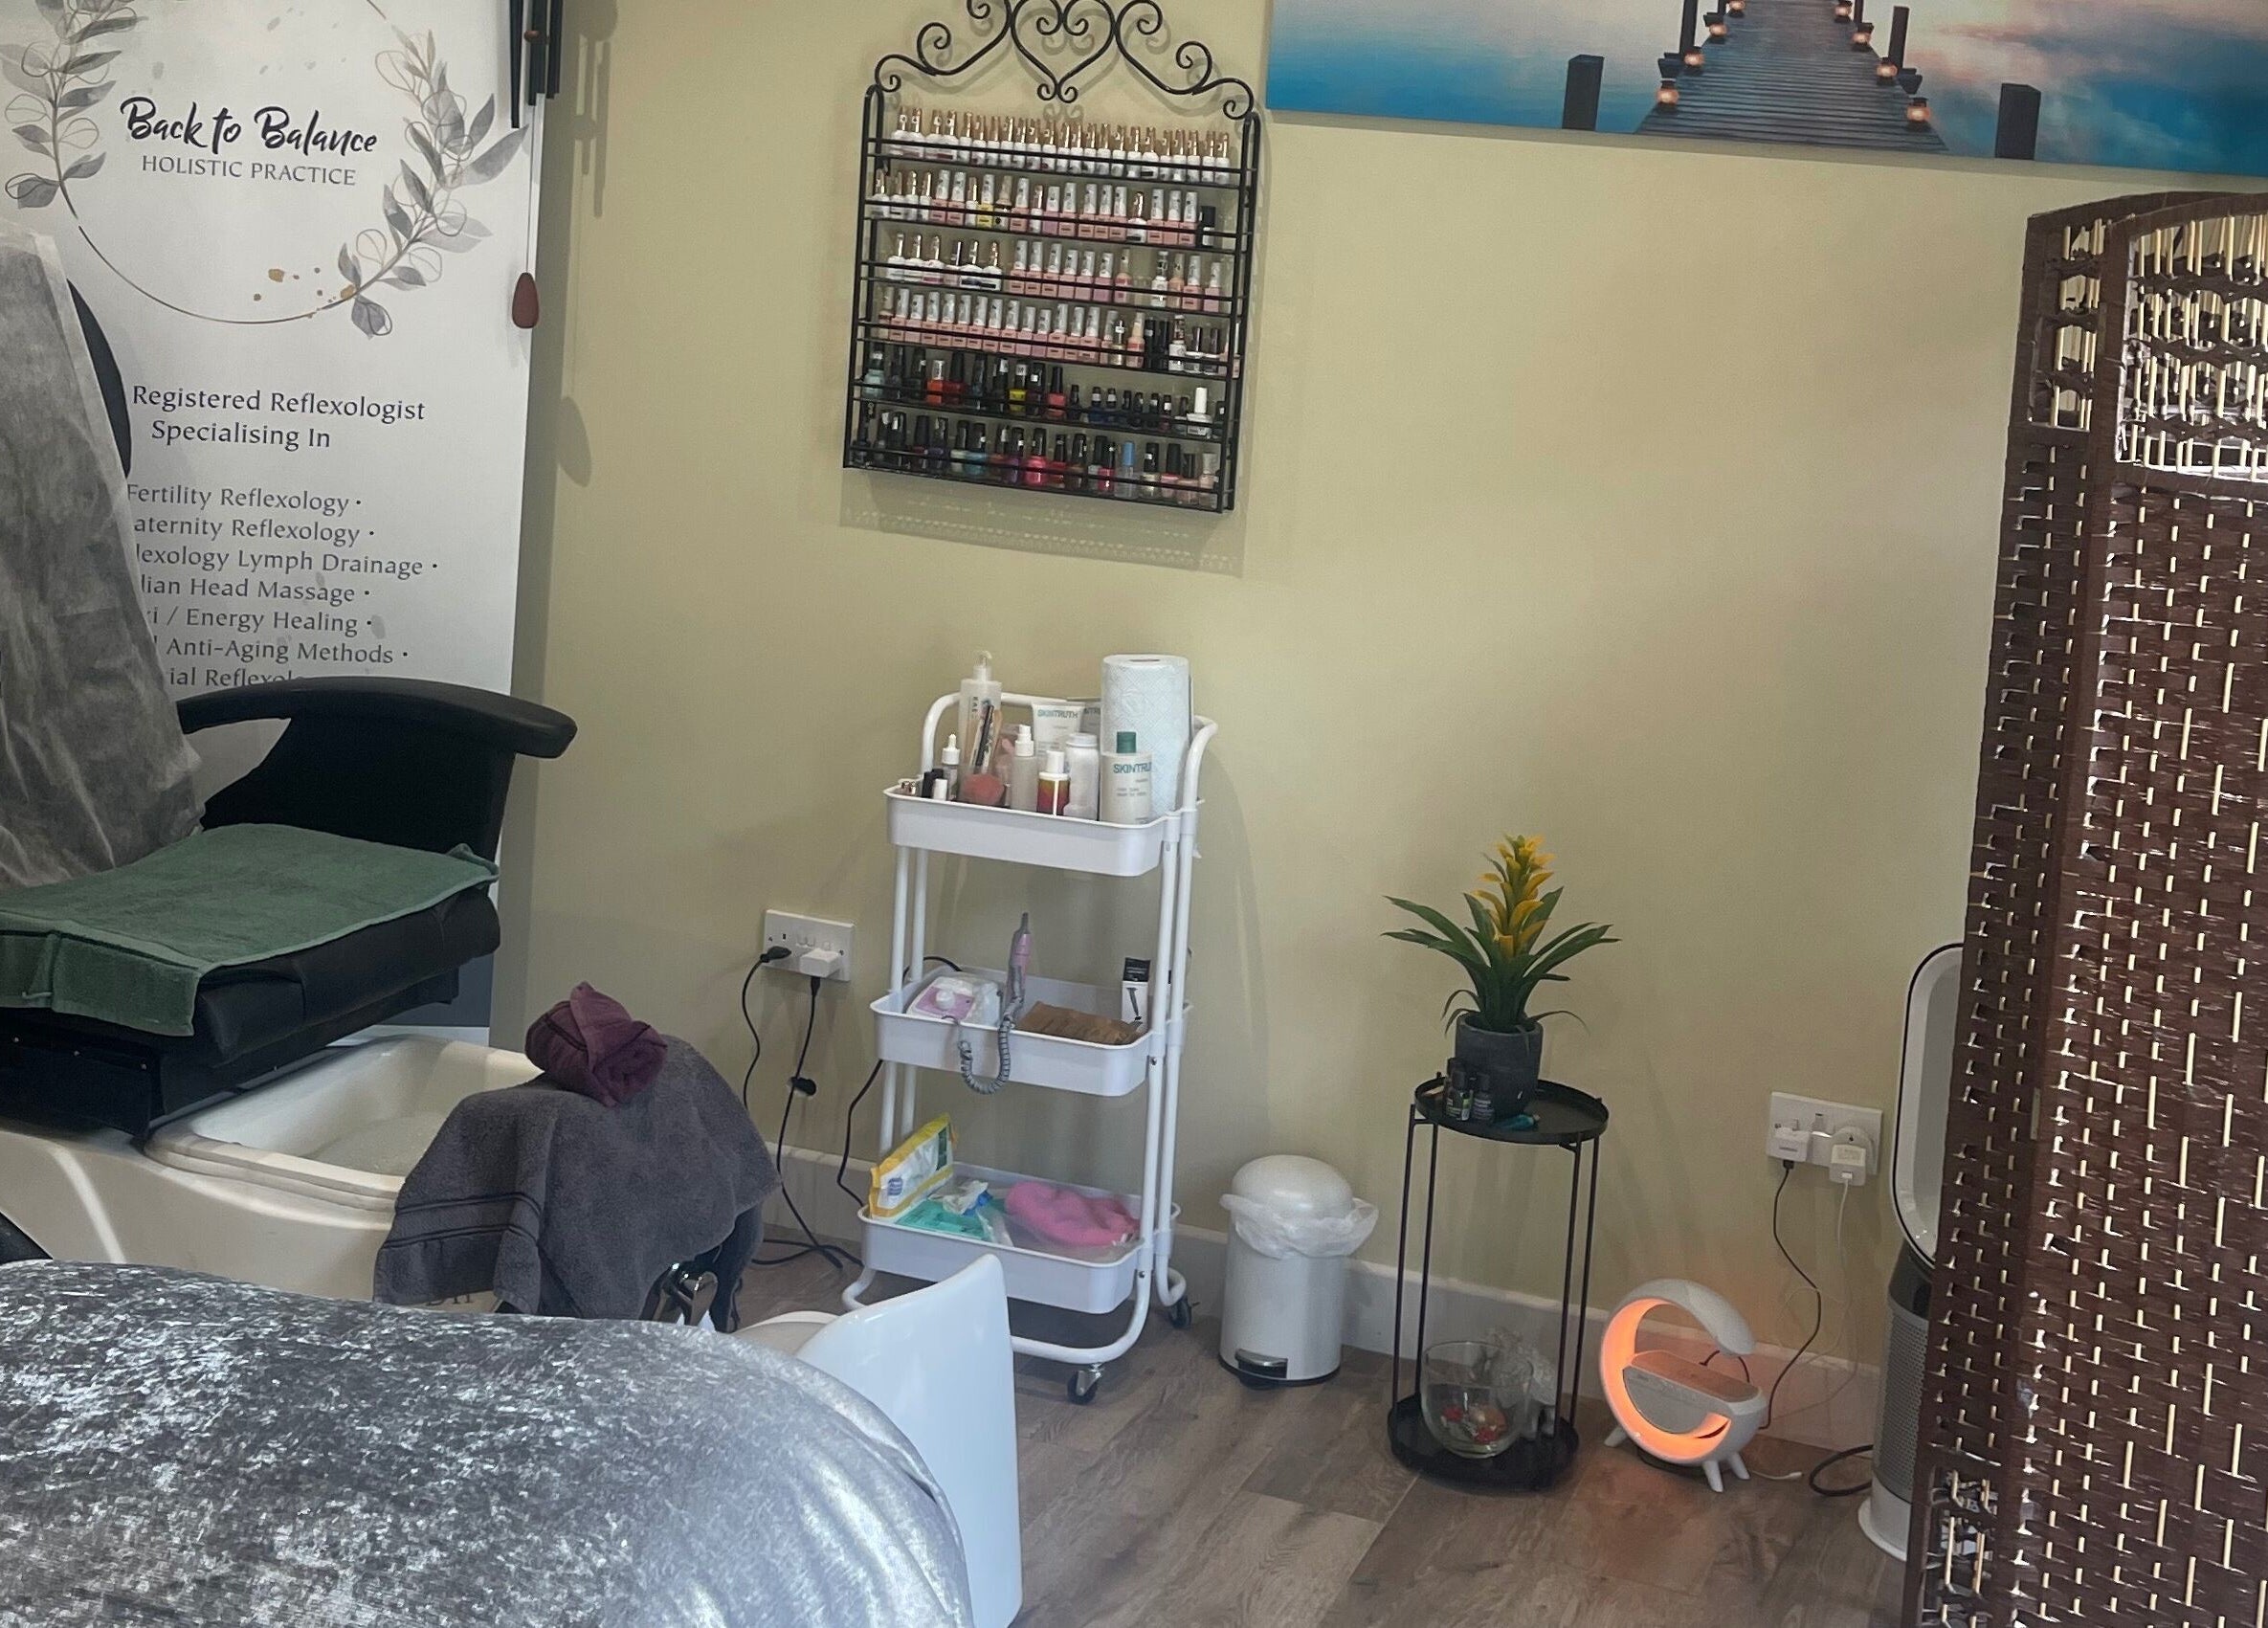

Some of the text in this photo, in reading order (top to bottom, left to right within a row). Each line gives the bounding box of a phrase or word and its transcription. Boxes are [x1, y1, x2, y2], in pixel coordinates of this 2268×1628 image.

[120, 96, 378, 156] Back to Balance
[142, 155, 357, 186] HOLISTIC PRACTICE
[133, 385, 426, 424] Registered Reflexologist
[151, 419, 331, 452] Specialising In
[126, 483, 350, 518] Fertility Reflexology
[134, 517, 361, 548] aternity Reflexology
[136, 543, 424, 581] lexology Lymph Drainage
[190, 577, 250, 597] Head
[257, 580, 356, 608] Massage
[186, 608, 265, 634] Energy
[273, 611, 359, 638] Healing
[166, 637, 394, 665] Anti-Aging Methods
[169, 667, 196, 686] ial
[1113, 761, 1152, 774] SKINTRU
